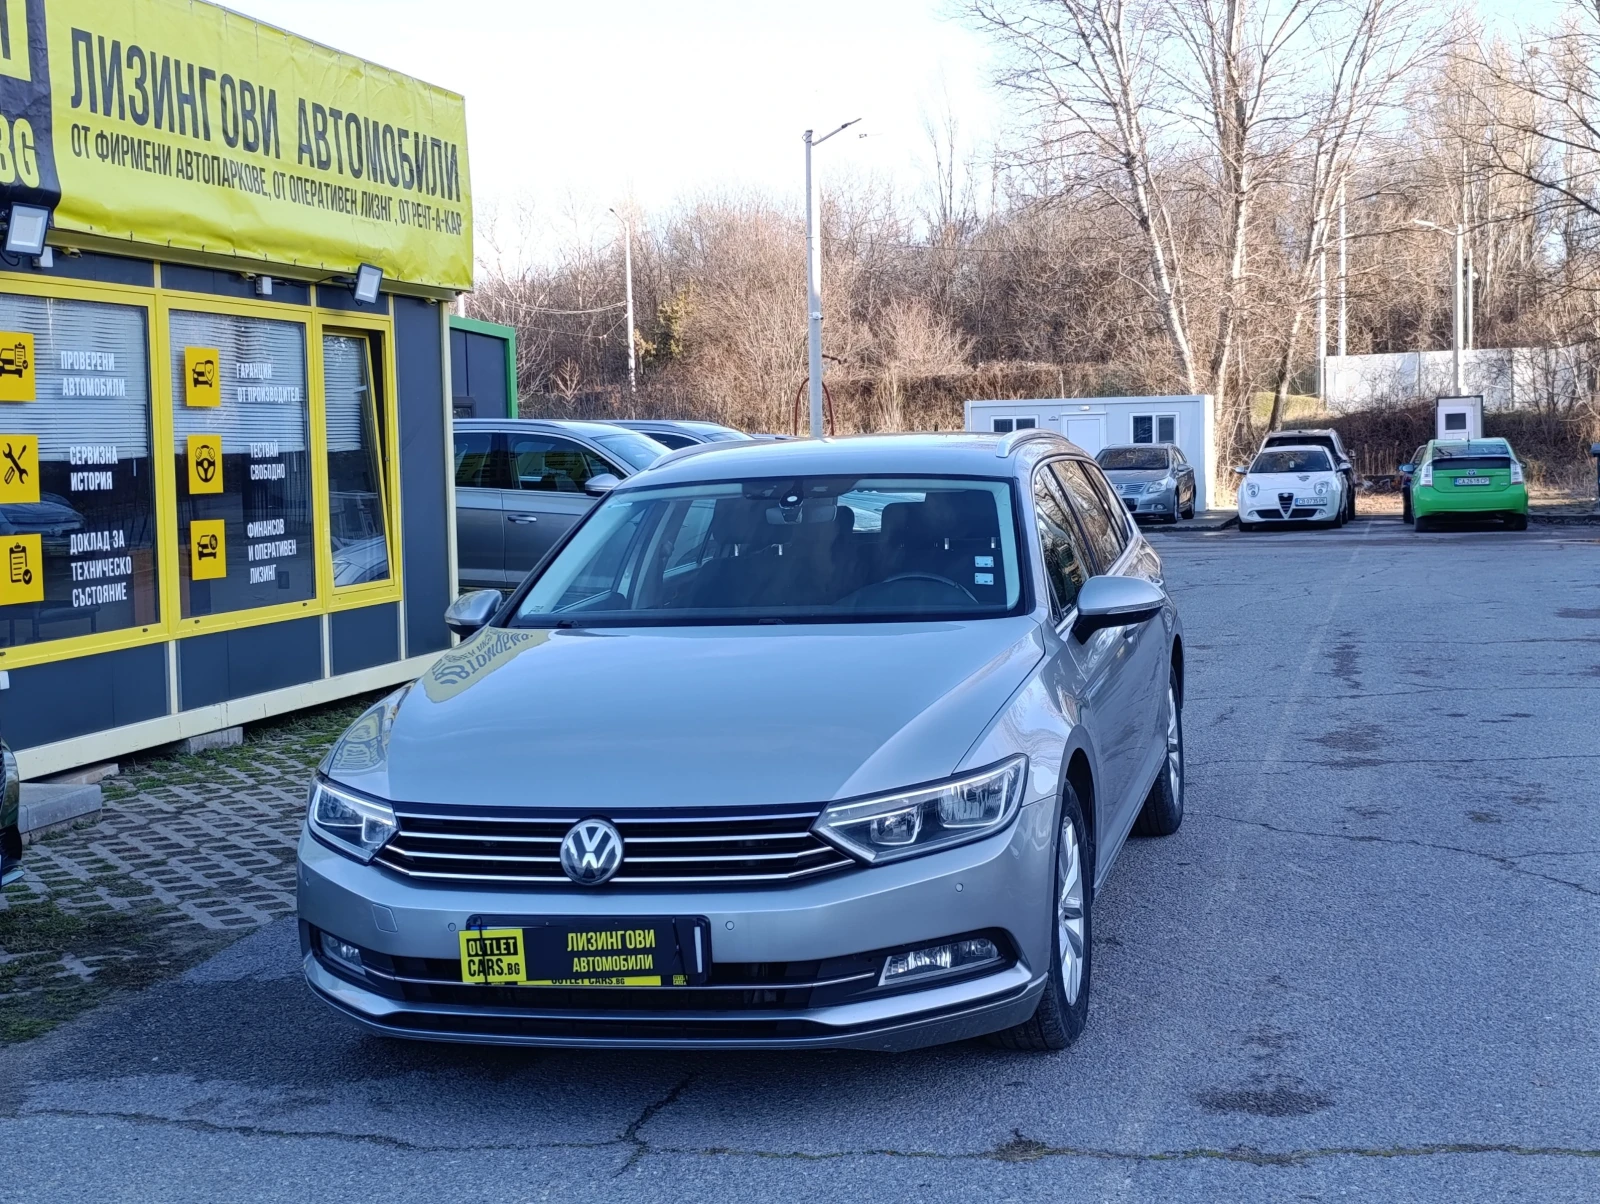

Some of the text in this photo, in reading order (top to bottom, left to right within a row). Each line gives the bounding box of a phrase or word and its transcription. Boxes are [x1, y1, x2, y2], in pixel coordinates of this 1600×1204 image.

[71, 27, 281, 159] ЛИЗИНГОВИ
[298, 97, 462, 203] АВТОМОБИЛИ
[71, 123, 91, 159] ОТ
[95, 130, 172, 177] ФИРМЕНИ
[176, 148, 272, 201] АВТОПАРКОВЕ,
[273, 170, 287, 201] ОТ
[289, 174, 358, 216] ОПЕРАТИВЕН
[399, 198, 411, 225] ОТ
[412, 203, 463, 236] РЕНТ-А-КАР
[60, 350, 115, 371] ПРОВЕРЕНИ
[236, 362, 272, 380] ГАРАНЦИЯ
[62, 377, 126, 397] АВТОМОБИЛИ
[237, 386, 300, 403] ОТ ПРОИЗВОДИТЕЛ
[69, 445, 118, 465] СЕРВИЗНА
[250, 439, 279, 458] ТЕСТВАЙ
[70, 471, 113, 491] ИСТОРИЯ
[250, 463, 285, 481] СВОБОДНО
[247, 518, 285, 539] ФИНАНСОВ
[70, 529, 125, 555] ДОКЛАД ЗА
[248, 539, 297, 562] И ОПЕРАТИВЕН
[70, 556, 132, 581] ТЕХНИЧЕСКО
[249, 564, 277, 585] ЛИЗИНГ
[72, 582, 127, 607] СЪСТОЯНИЕ
[468, 939, 516, 955] OUTLET
[567, 929, 656, 951] ЛИЗИНГОВИ
[572, 954, 654, 973] АВТОМОБИЛИ
